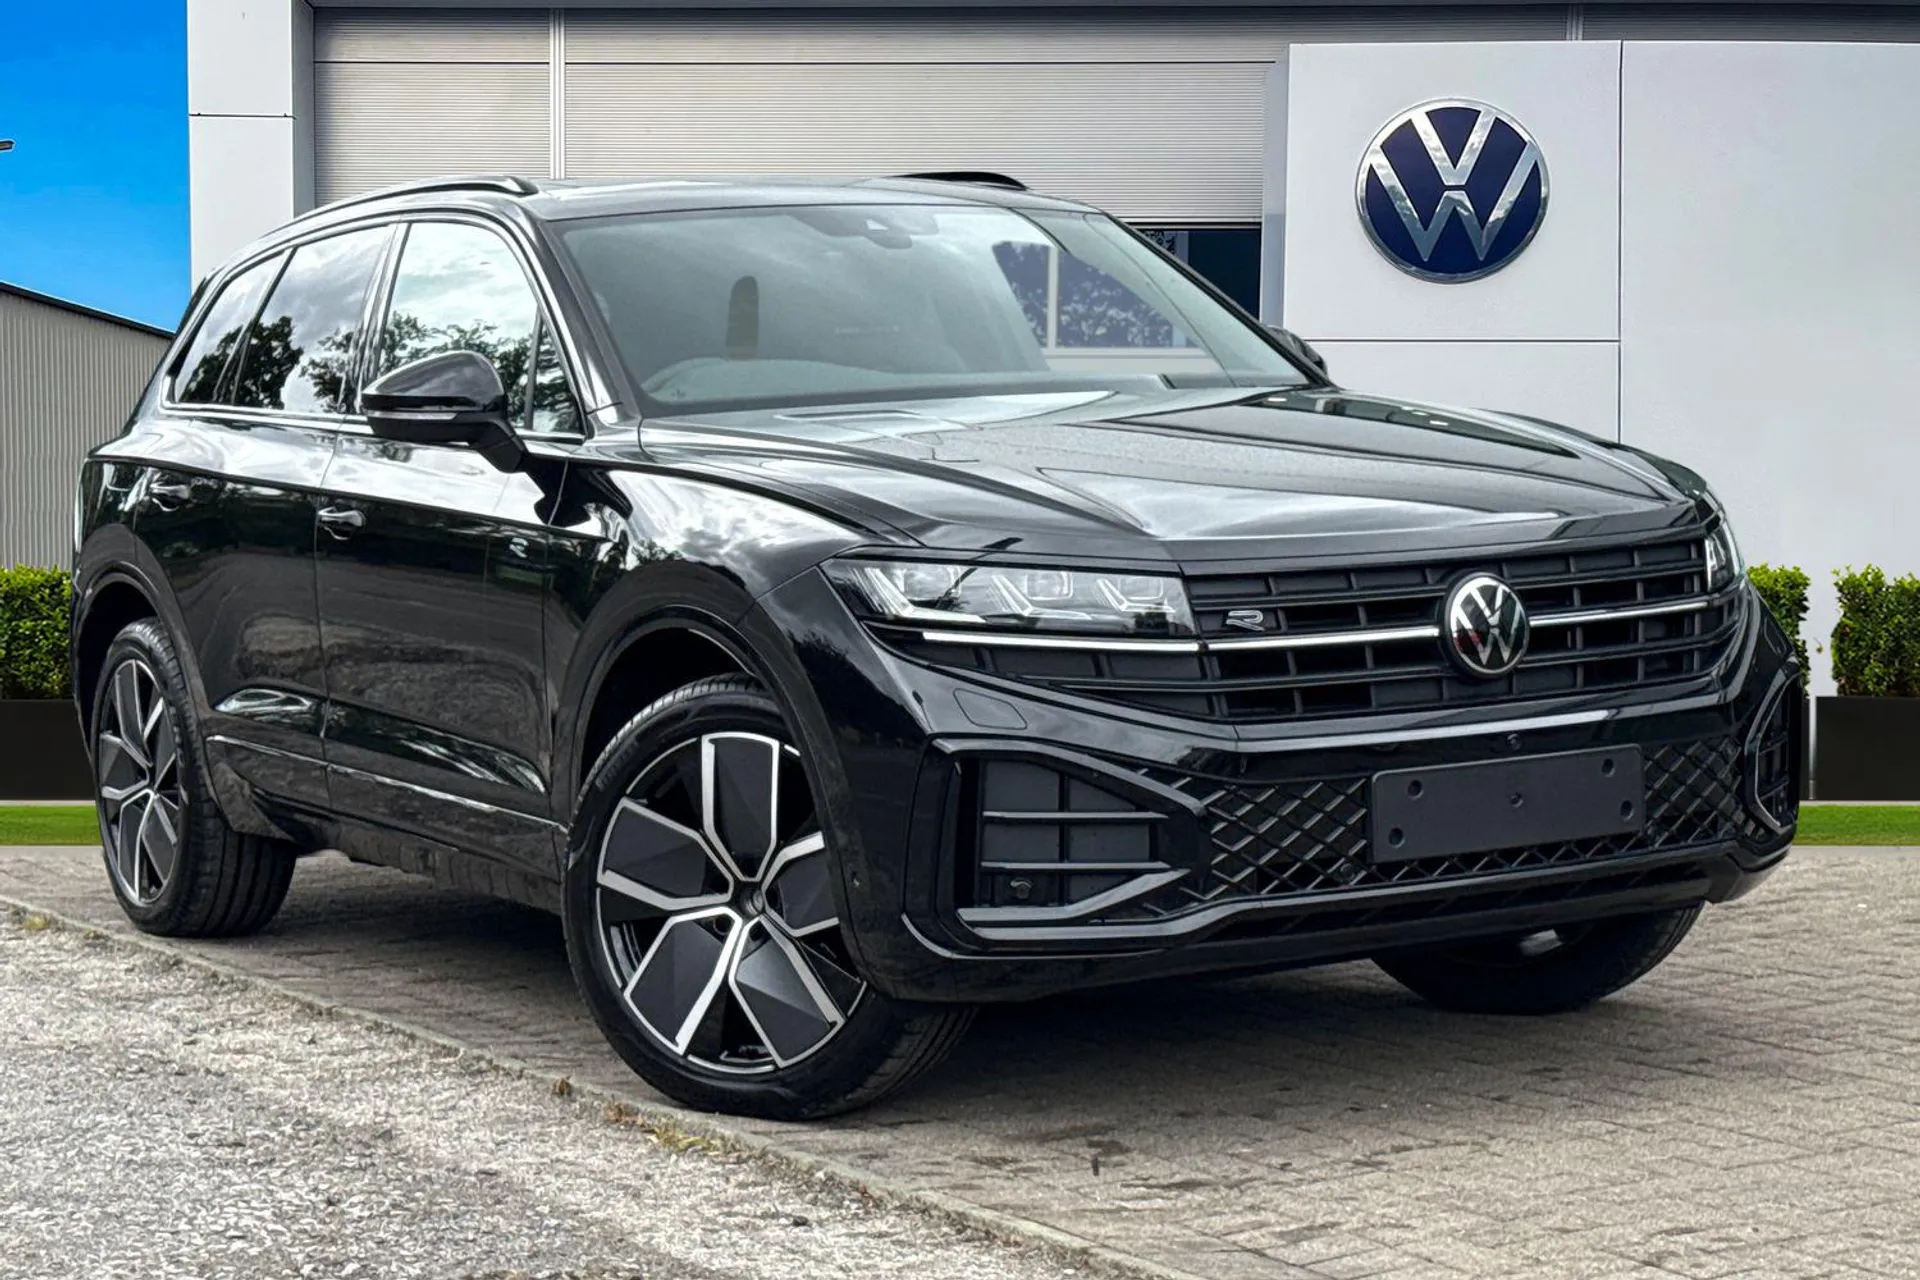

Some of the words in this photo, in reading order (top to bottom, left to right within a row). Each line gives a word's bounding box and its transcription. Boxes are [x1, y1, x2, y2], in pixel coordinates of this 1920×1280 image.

[1362, 104, 1543, 268] VW
[1225, 609, 1265, 632] R
[1452, 580, 1525, 668] VW
